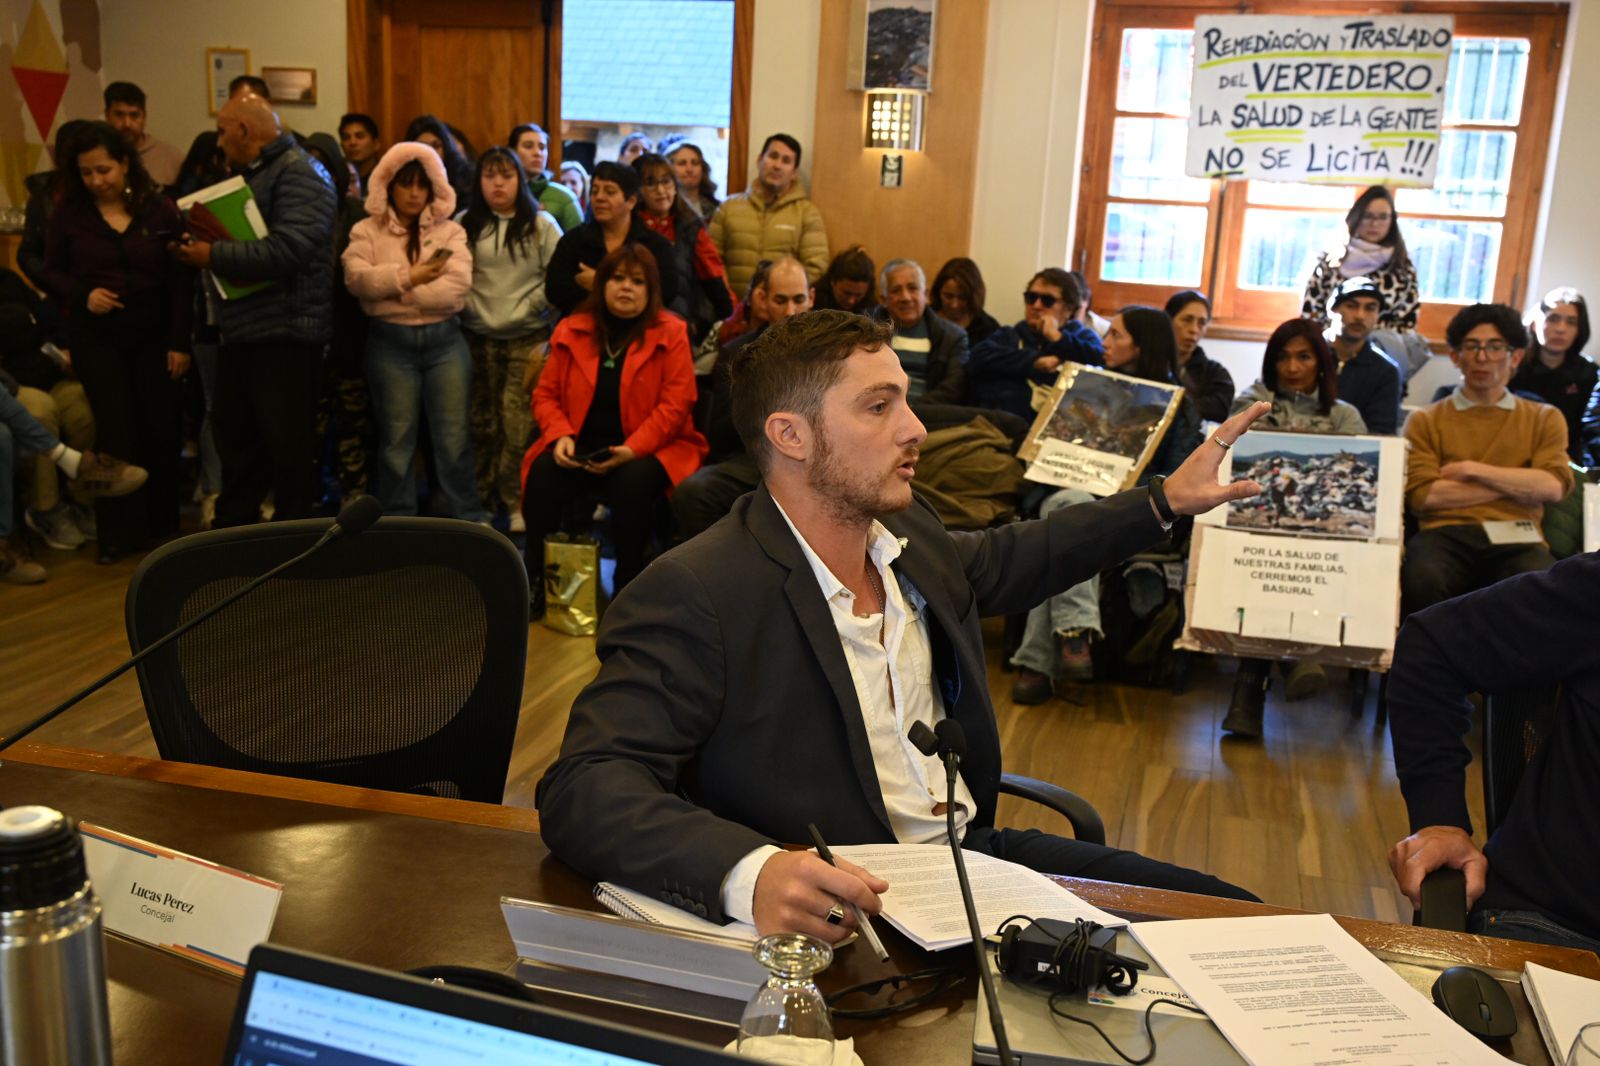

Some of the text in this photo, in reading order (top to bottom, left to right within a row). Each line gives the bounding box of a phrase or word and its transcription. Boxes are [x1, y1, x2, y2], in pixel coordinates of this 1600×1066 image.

[1344, 21, 1451, 50] TRASLADO
[1219, 73, 1248, 89] DEL
[1199, 101, 1438, 131] LA SALUD DE LA GENTE
[1204, 148, 1244, 174] NO
[1260, 149, 1292, 169] SE
[1243, 546, 1340, 561] POR LA SALUD DE
[1234, 558, 1291, 570] NUESTRAS
[1251, 571, 1329, 585] CERREMOS EL
[130, 882, 194, 914] Lucas Perez
[140, 905, 175, 923] Concejal
